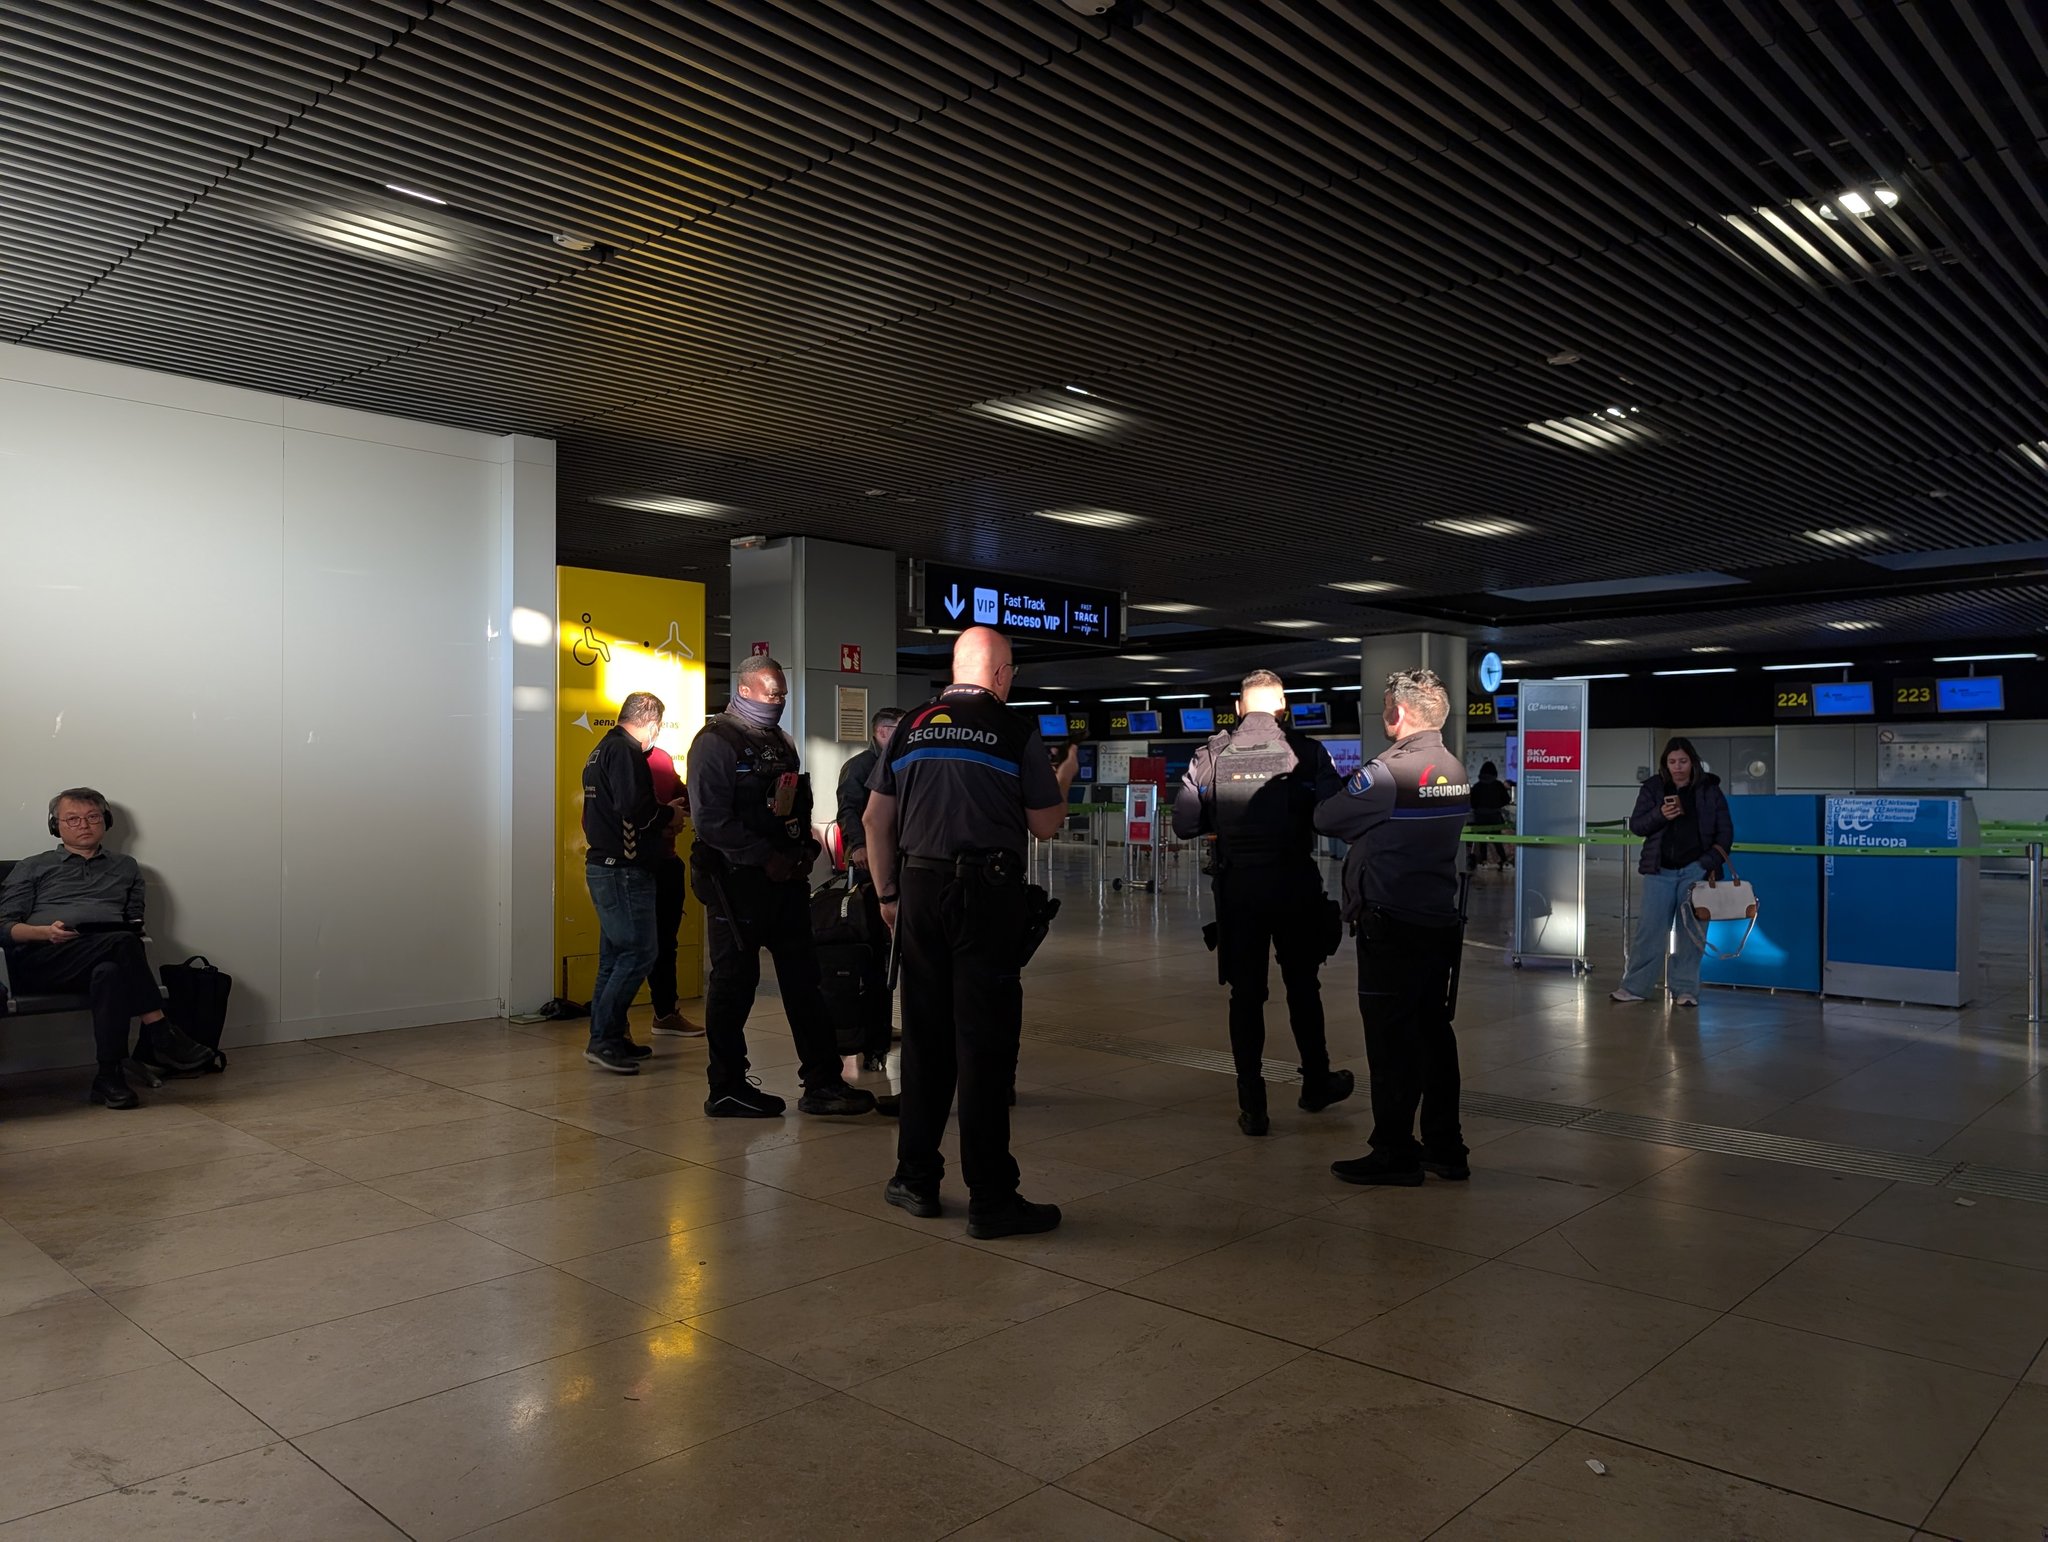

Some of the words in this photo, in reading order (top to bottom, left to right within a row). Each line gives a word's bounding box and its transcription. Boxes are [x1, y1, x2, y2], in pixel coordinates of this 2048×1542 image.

[976, 598, 995, 613] VIP
[1004, 593, 1021, 608] Fast
[1023, 595, 1046, 611] Track
[1080, 603, 1092, 611] FAST
[1003, 610, 1041, 629] Acceso
[1043, 615, 1060, 631] VIP
[1074, 611, 1099, 624] TRACK
[1777, 692, 1808, 707] 224
[1897, 687, 1931, 703] 223
[1468, 702, 1493, 716] 225
[593, 718, 616, 727] aena
[1070, 719, 1086, 729] 230
[1111, 717, 1128, 728] 229
[1216, 713, 1235, 724] 228
[907, 727, 998, 745] SEGURIDAD
[1526, 748, 1547, 756] SKY
[1526, 755, 1572, 764] PRIORITY
[1838, 833, 1907, 848] AirEuropa
